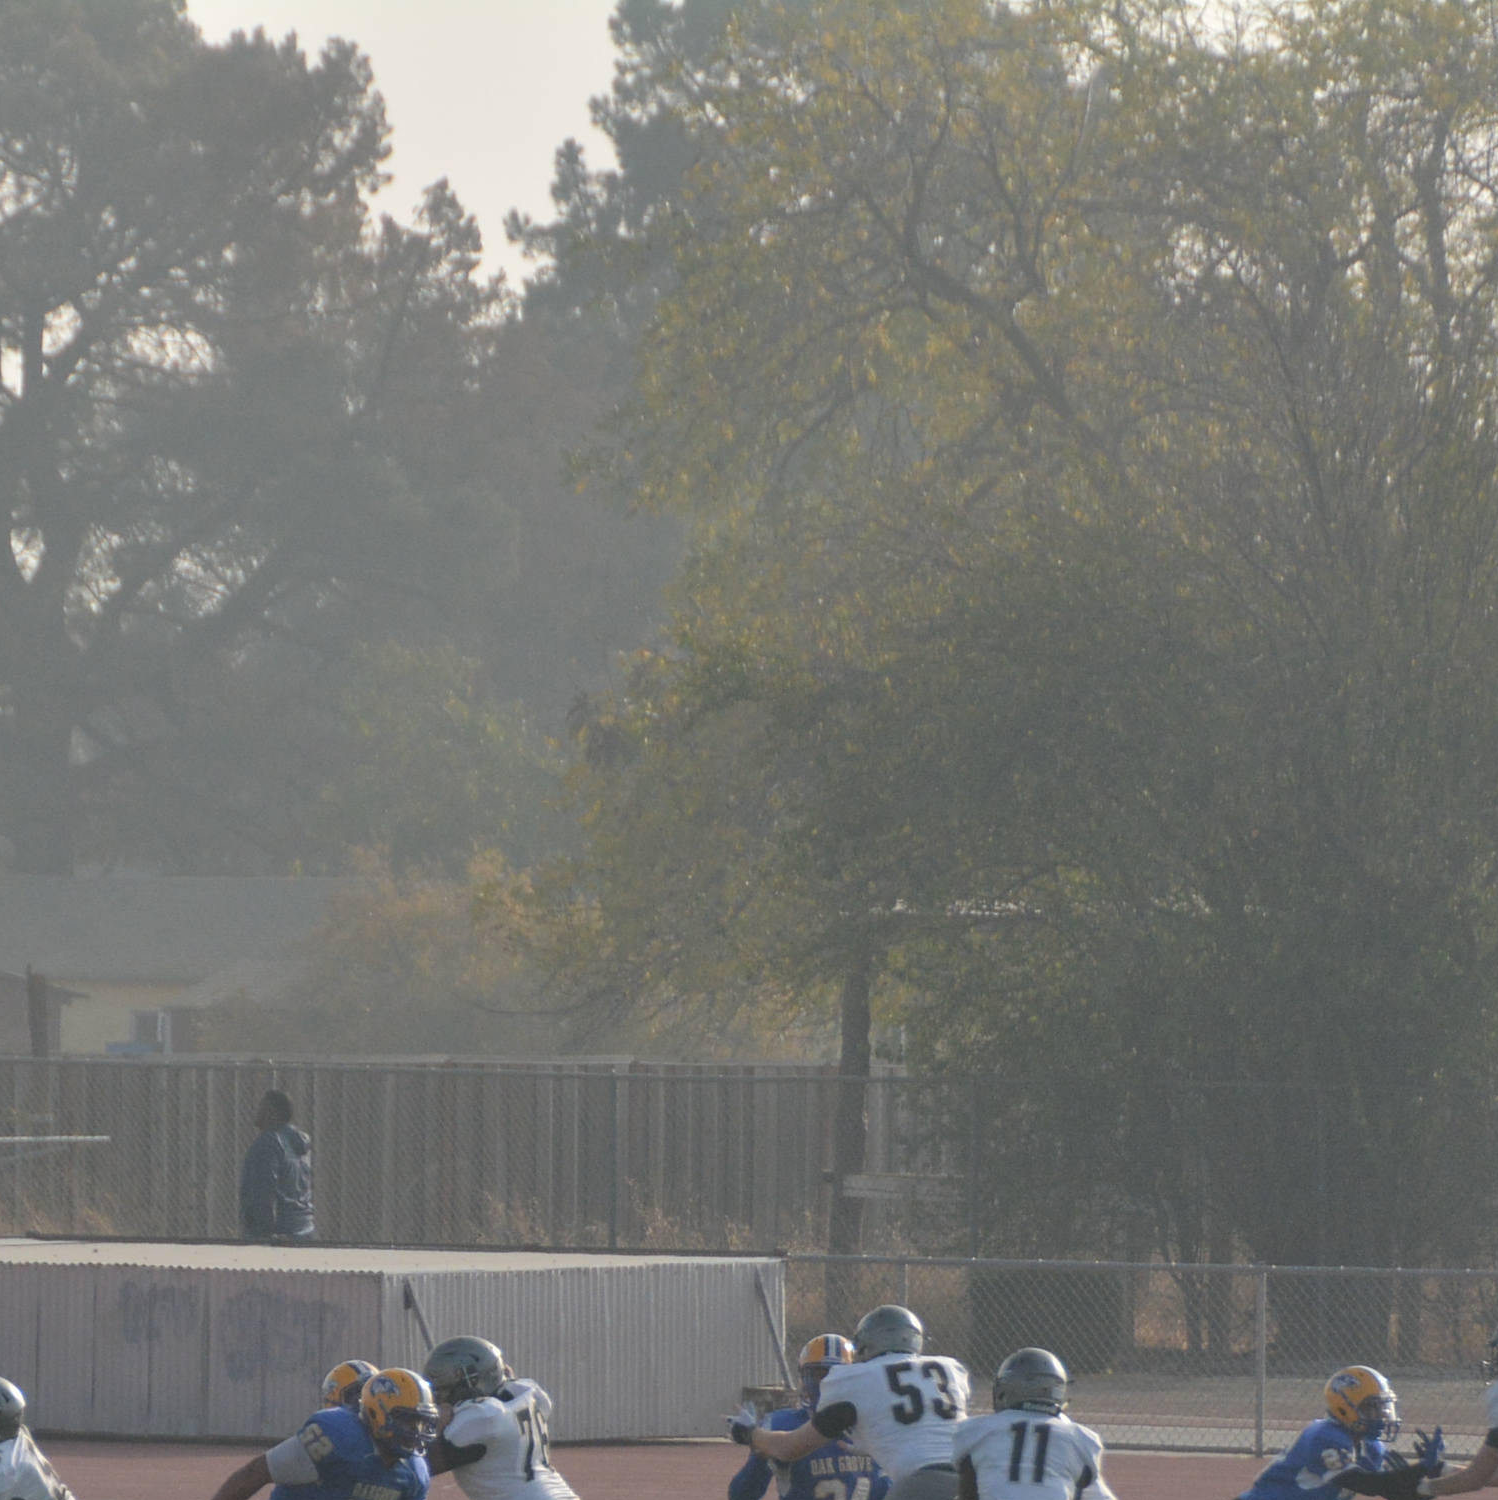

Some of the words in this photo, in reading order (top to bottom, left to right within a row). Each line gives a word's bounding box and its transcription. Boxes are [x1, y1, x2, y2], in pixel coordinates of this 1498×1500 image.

[885, 1360, 957, 1425] 53
[811, 1457, 835, 1475] OAK
[1009, 1421, 1050, 1482] 11
